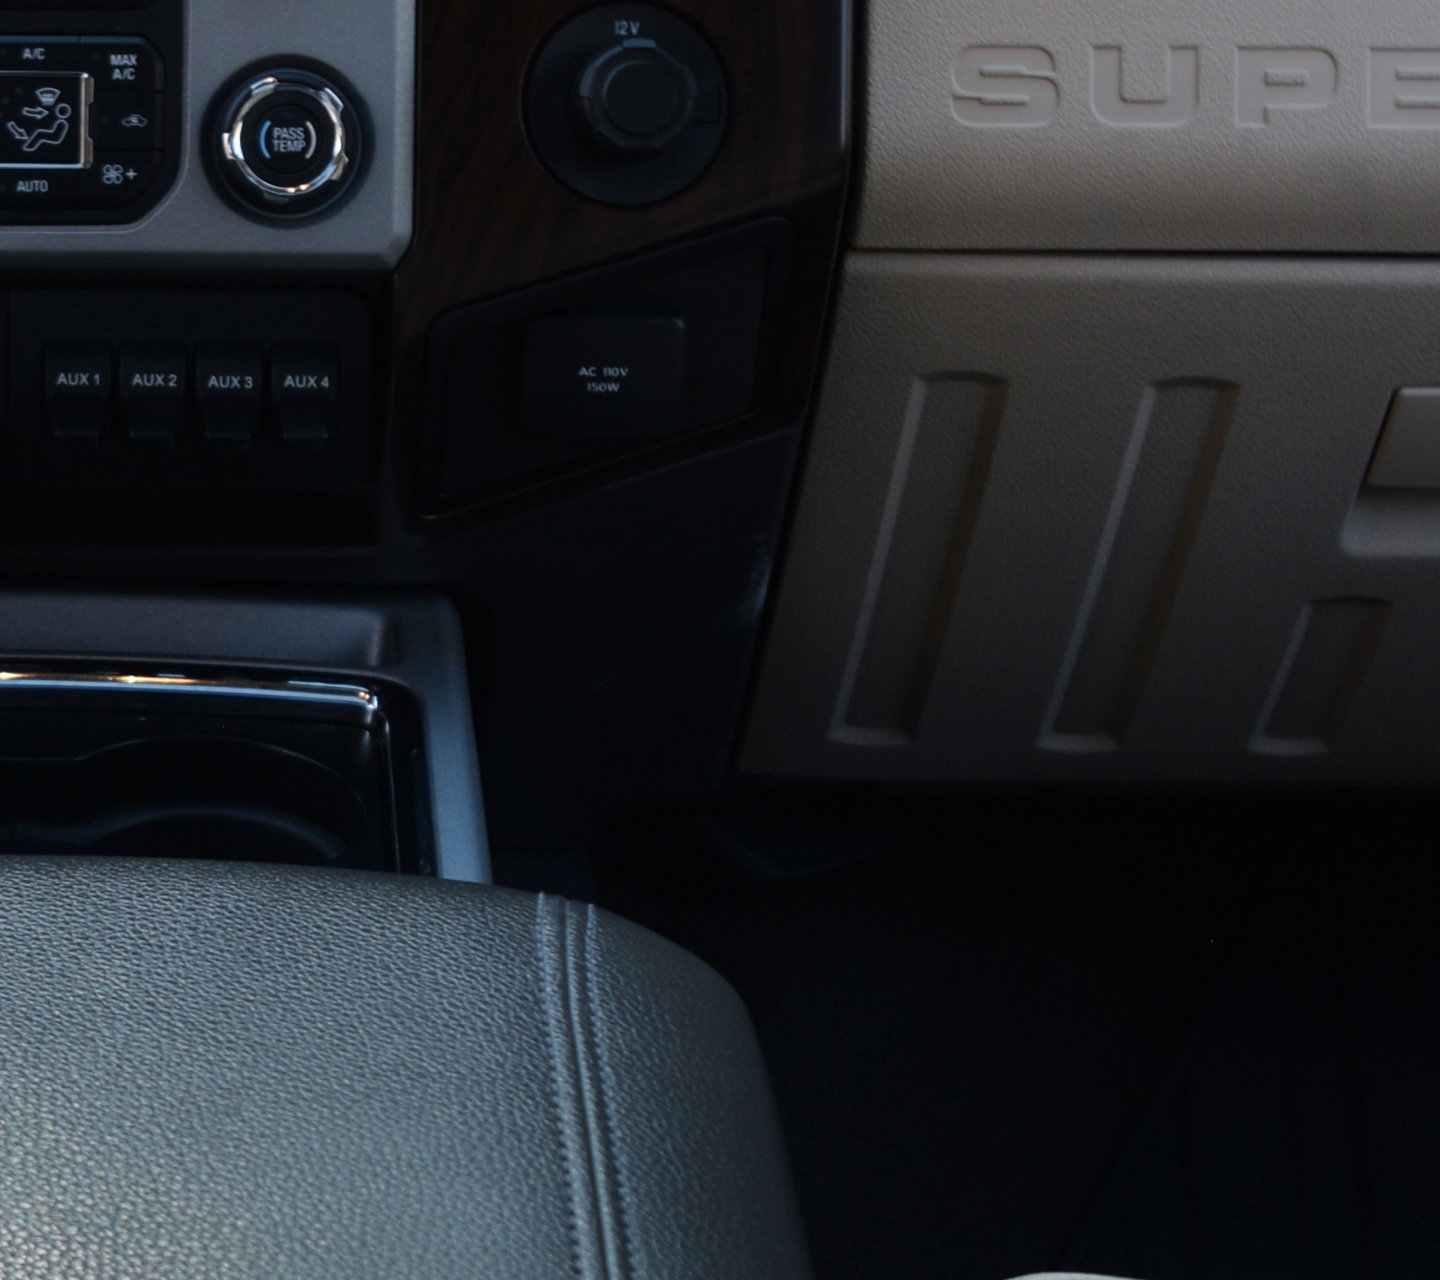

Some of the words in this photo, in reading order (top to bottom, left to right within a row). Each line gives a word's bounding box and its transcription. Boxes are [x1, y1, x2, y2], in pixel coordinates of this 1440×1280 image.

[22, 47, 47, 61] A/C
[109, 53, 139, 67] MAX
[111, 68, 137, 81] A/C
[272, 126, 306, 140] PASS
[272, 139, 307, 152] TEMP
[16, 179, 50, 193] AUTO
[578, 366, 598, 377] AC
[56, 373, 90, 386] AUX
[131, 373, 166, 387] AUX
[168, 374, 178, 387] 2
[207, 375, 242, 389] AUX
[244, 376, 254, 390] 3
[283, 375, 318, 389] AUX
[320, 375, 330, 389] 4
[586, 381, 621, 393] 150W
